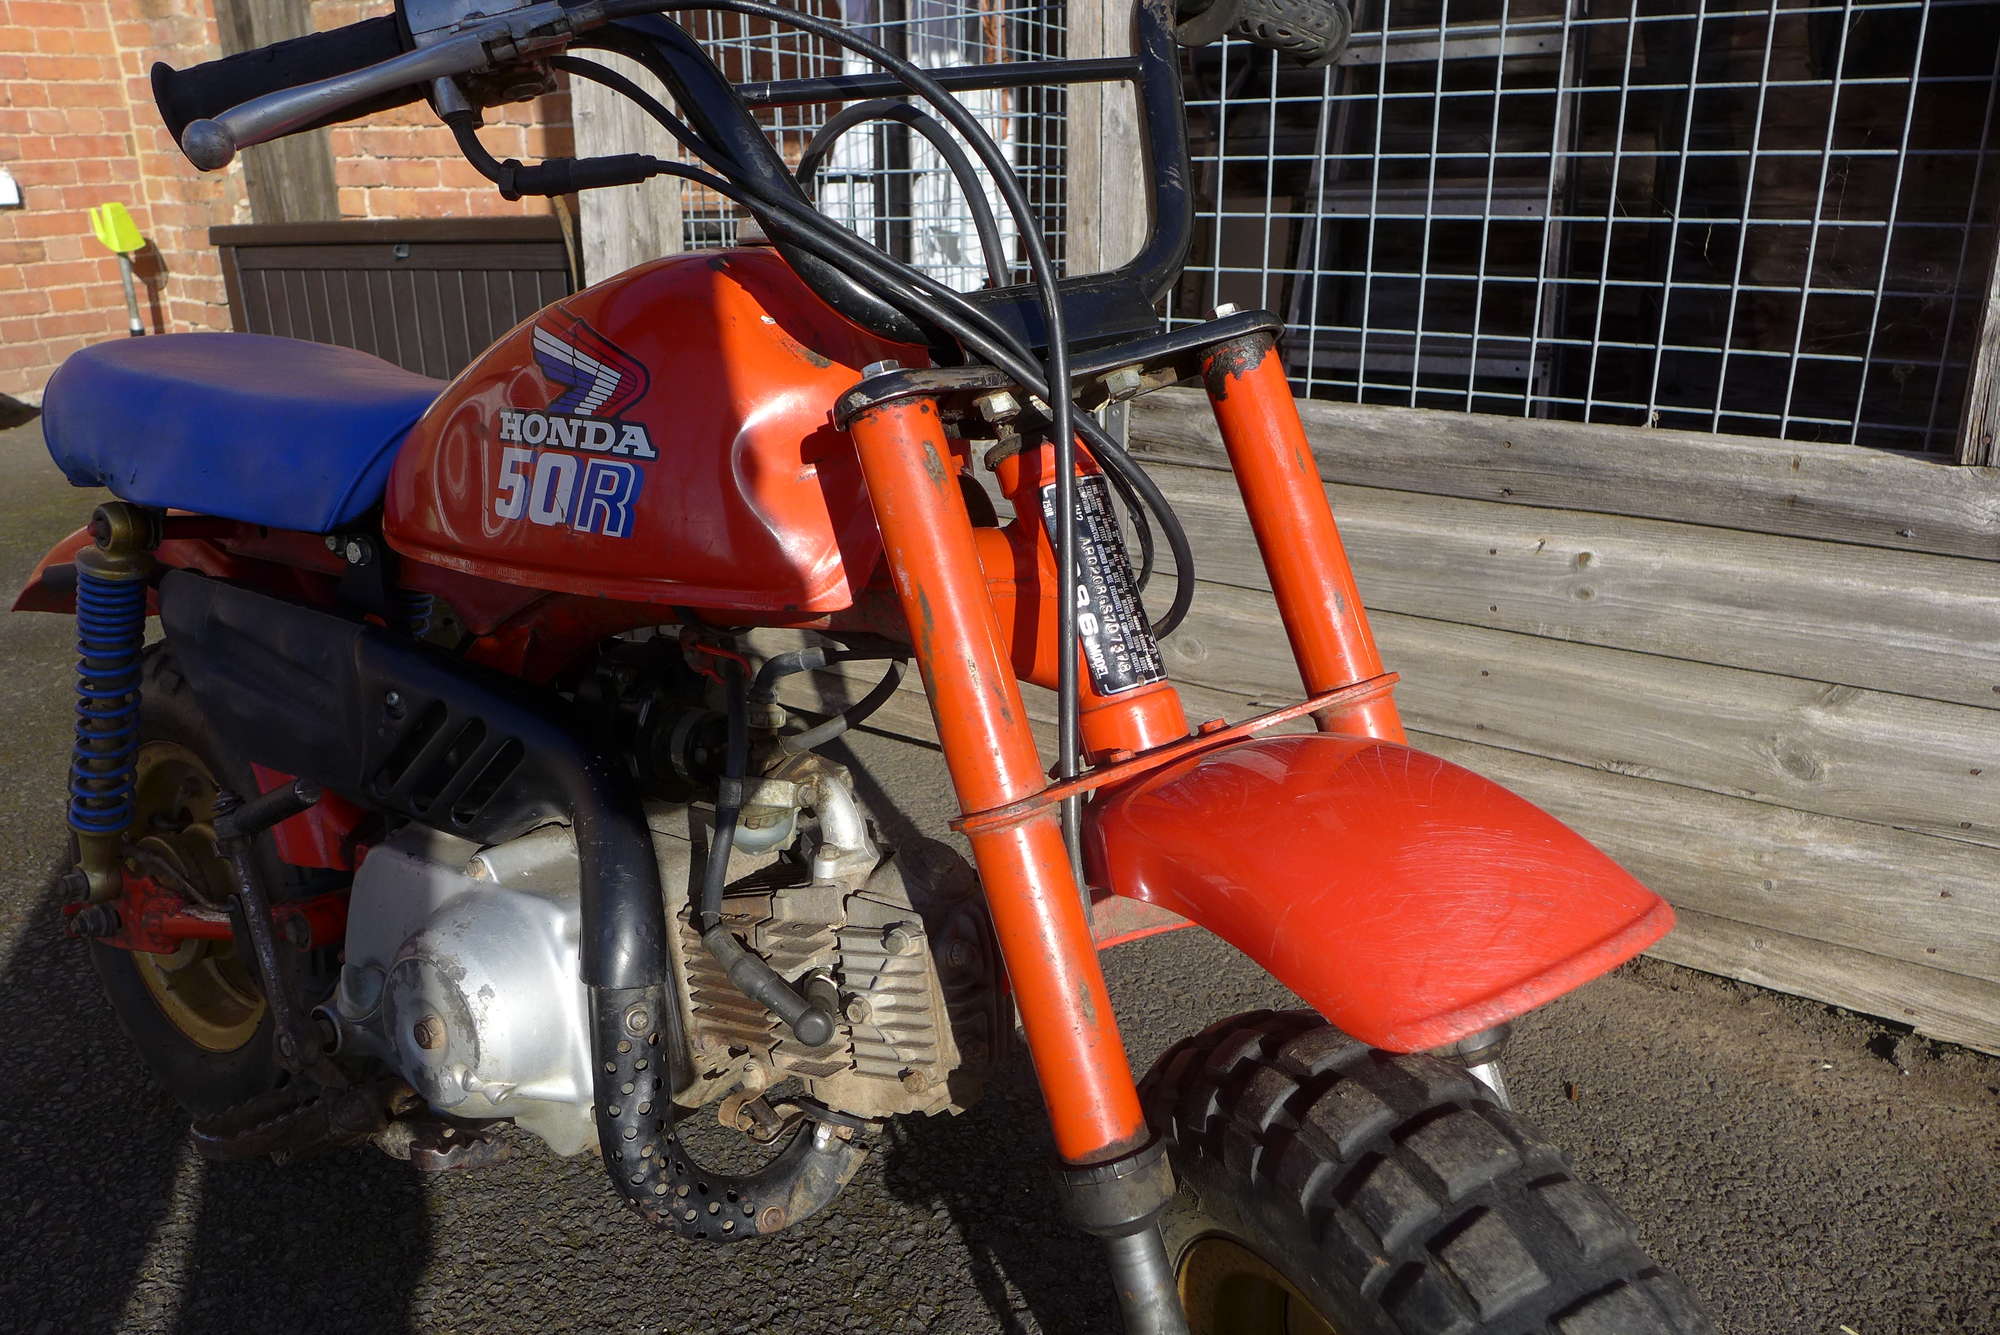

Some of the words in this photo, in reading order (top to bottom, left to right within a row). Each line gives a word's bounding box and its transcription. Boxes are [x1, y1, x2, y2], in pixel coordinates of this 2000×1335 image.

[499, 410, 657, 458] HONDA
[494, 447, 644, 538] 50R
[1089, 643, 1109, 679] MODEL
[1109, 585, 1123, 612] EXCLUSIVELY
[1130, 652, 1142, 672] CIRCUITS
